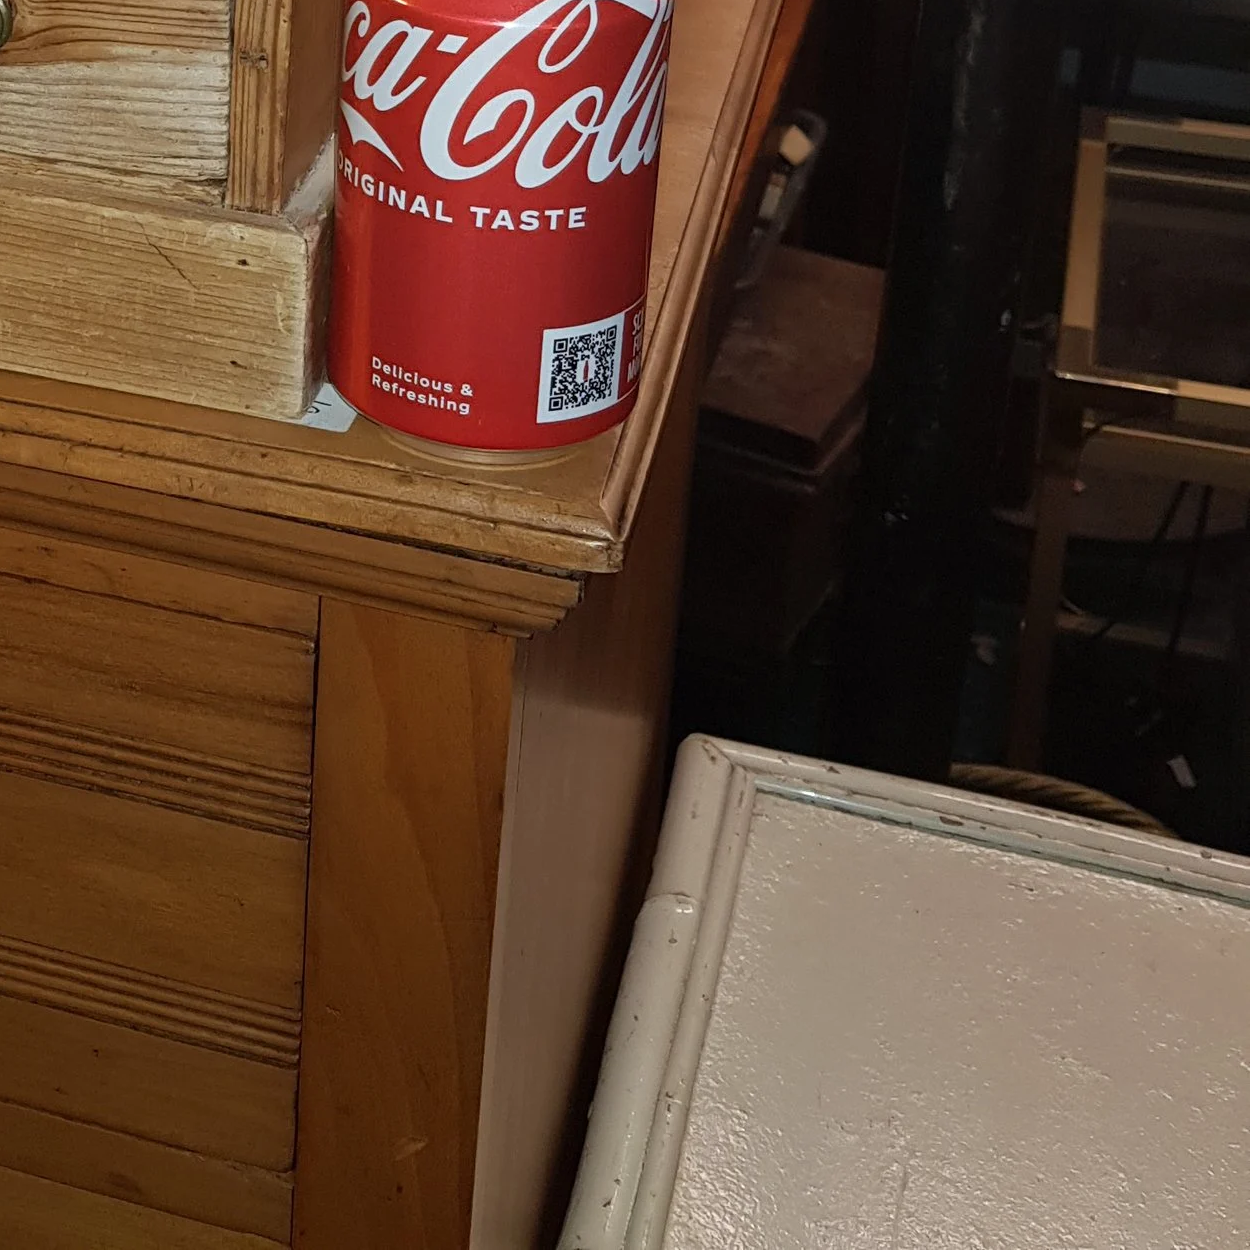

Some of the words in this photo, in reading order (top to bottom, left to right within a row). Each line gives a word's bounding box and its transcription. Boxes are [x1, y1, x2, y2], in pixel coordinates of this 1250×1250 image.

[470, 206, 587, 231] TASTE
[371, 373, 470, 415] Refreshing
[372, 356, 453, 393] Delicious
[460, 383, 474, 397] &
